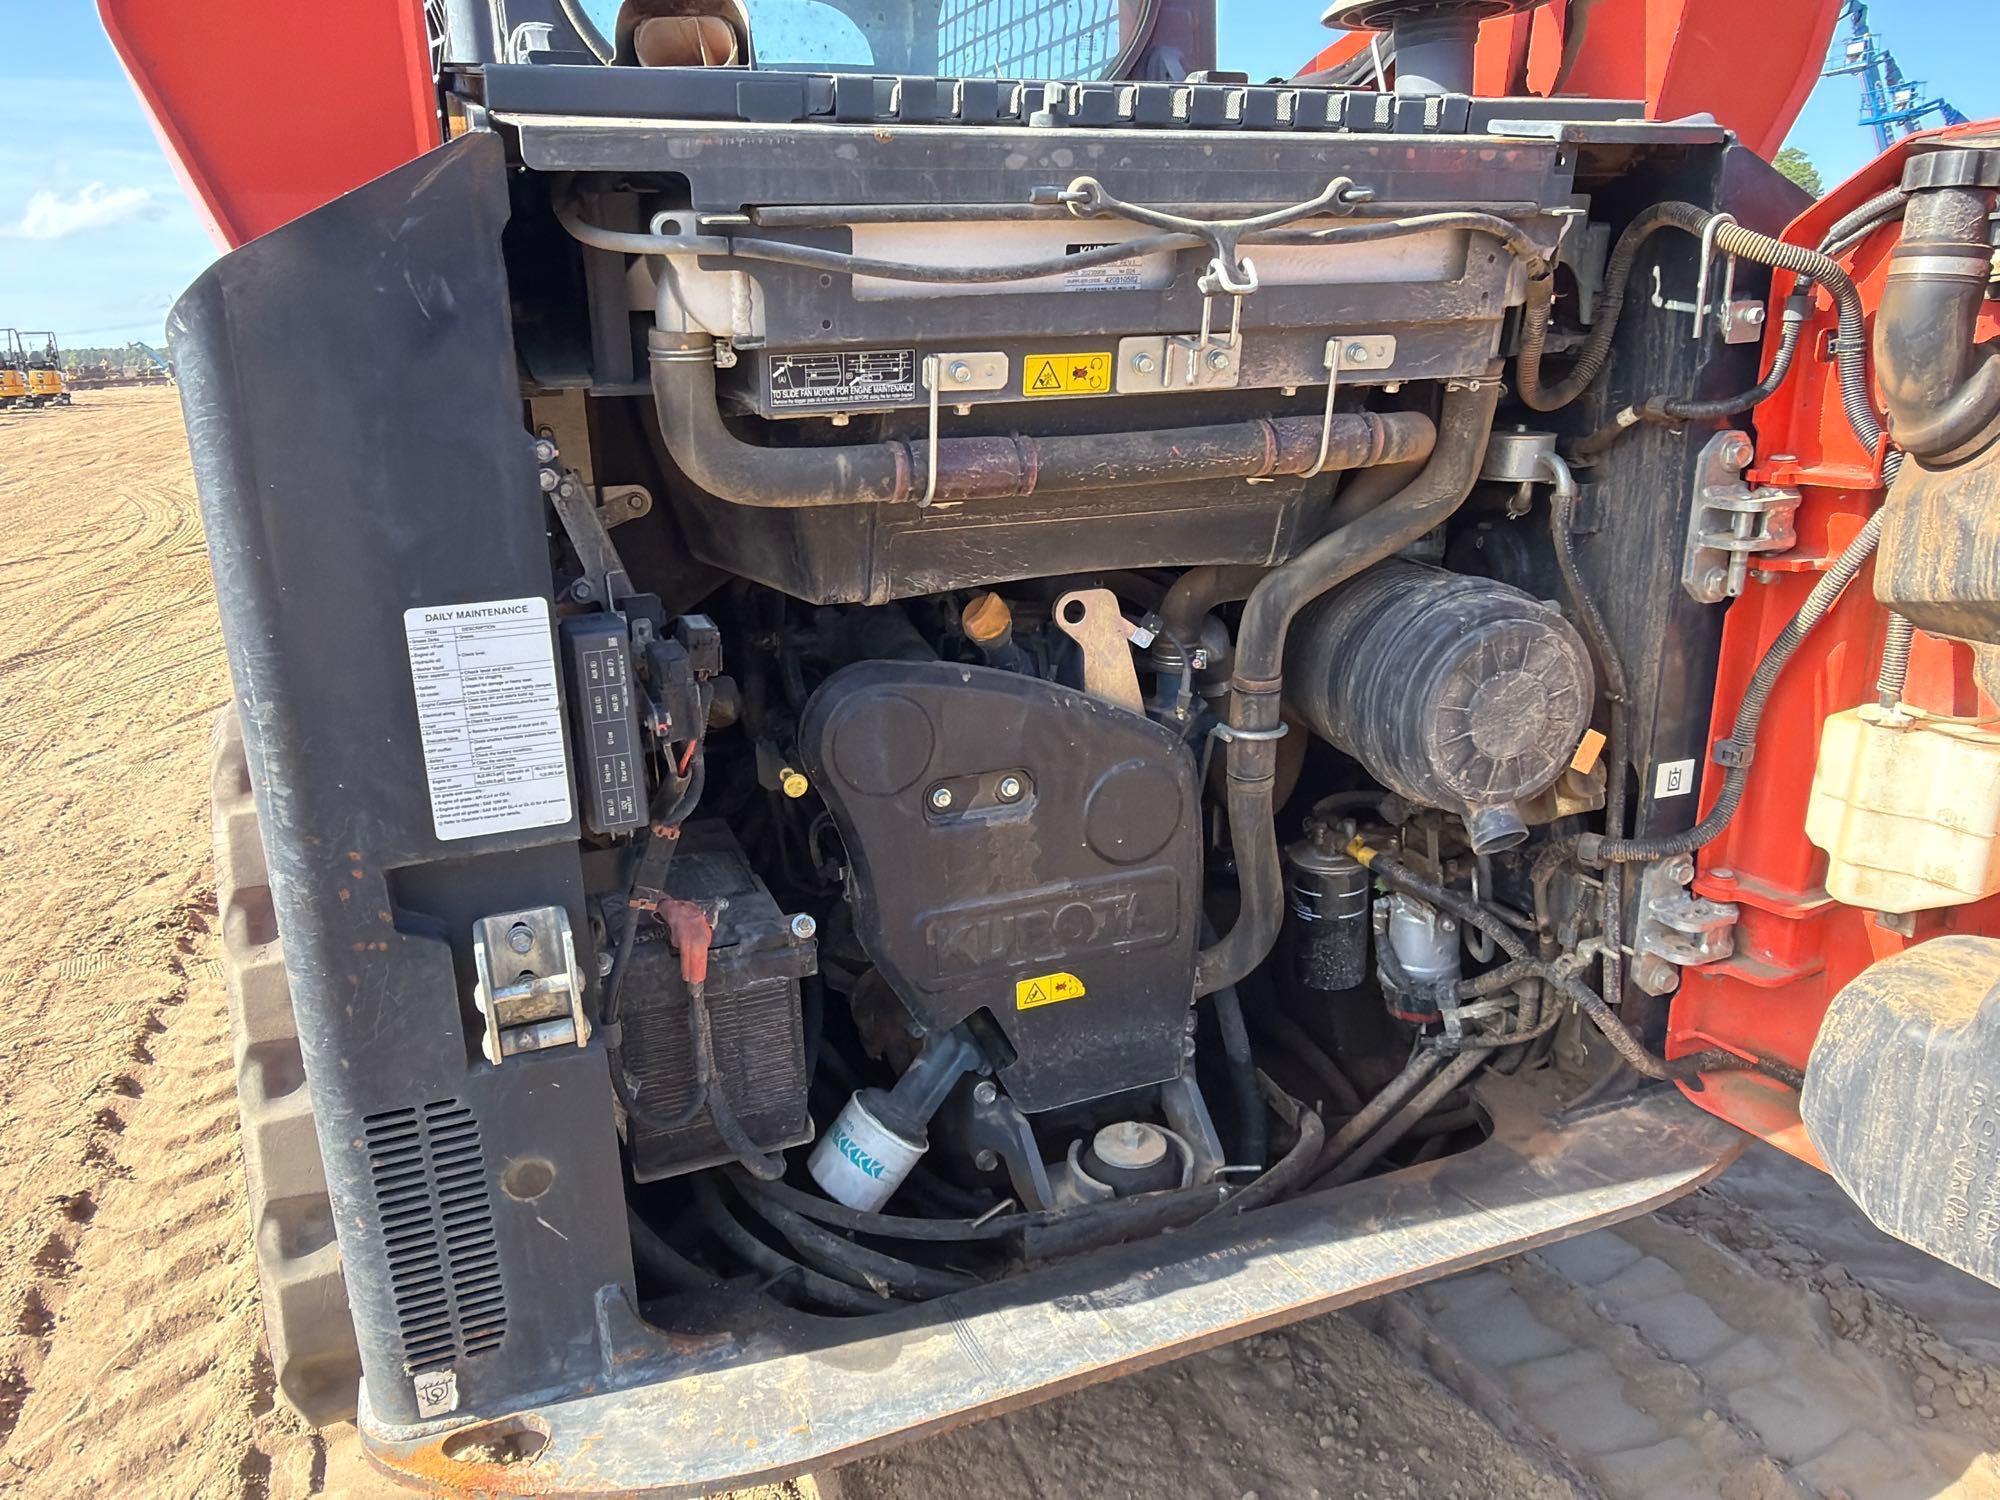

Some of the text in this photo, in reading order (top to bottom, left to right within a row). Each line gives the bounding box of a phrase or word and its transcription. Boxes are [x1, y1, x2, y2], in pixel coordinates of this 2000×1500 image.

[772, 382, 914, 399] TO SLIDE FAN MOTOR FOR ENGINE MAINTENANCE
[425, 604, 529, 622] DAILY MAINTENANCE
[603, 764, 611, 783] Engine
[620, 760, 628, 782] Starter
